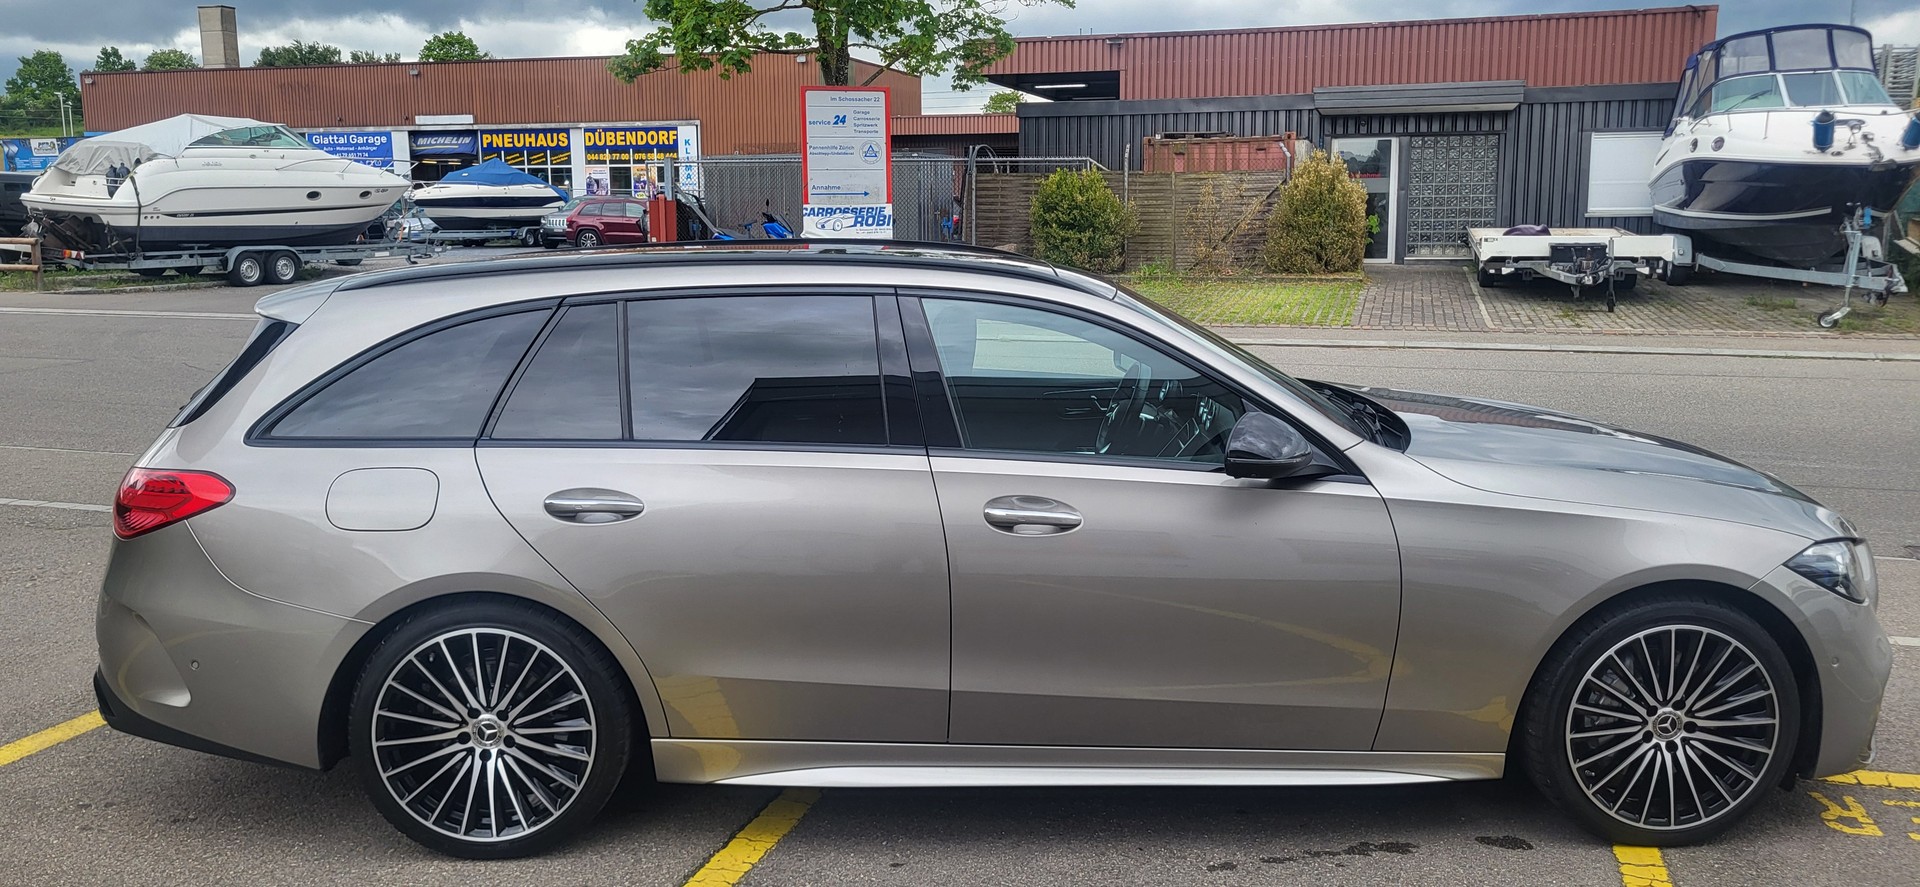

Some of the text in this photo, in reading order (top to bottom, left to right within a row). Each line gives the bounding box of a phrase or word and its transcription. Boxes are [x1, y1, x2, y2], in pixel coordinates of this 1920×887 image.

[832, 114, 847, 126] 24
[312, 134, 387, 147] Glattal Garage
[416, 136, 472, 145] MICHELIN
[482, 131, 569, 148] PNEUHAUS
[585, 129, 677, 146] DÜBENDORF
[634, 152, 646, 160] 076
[803, 206, 887, 217] CARROSSERIE
